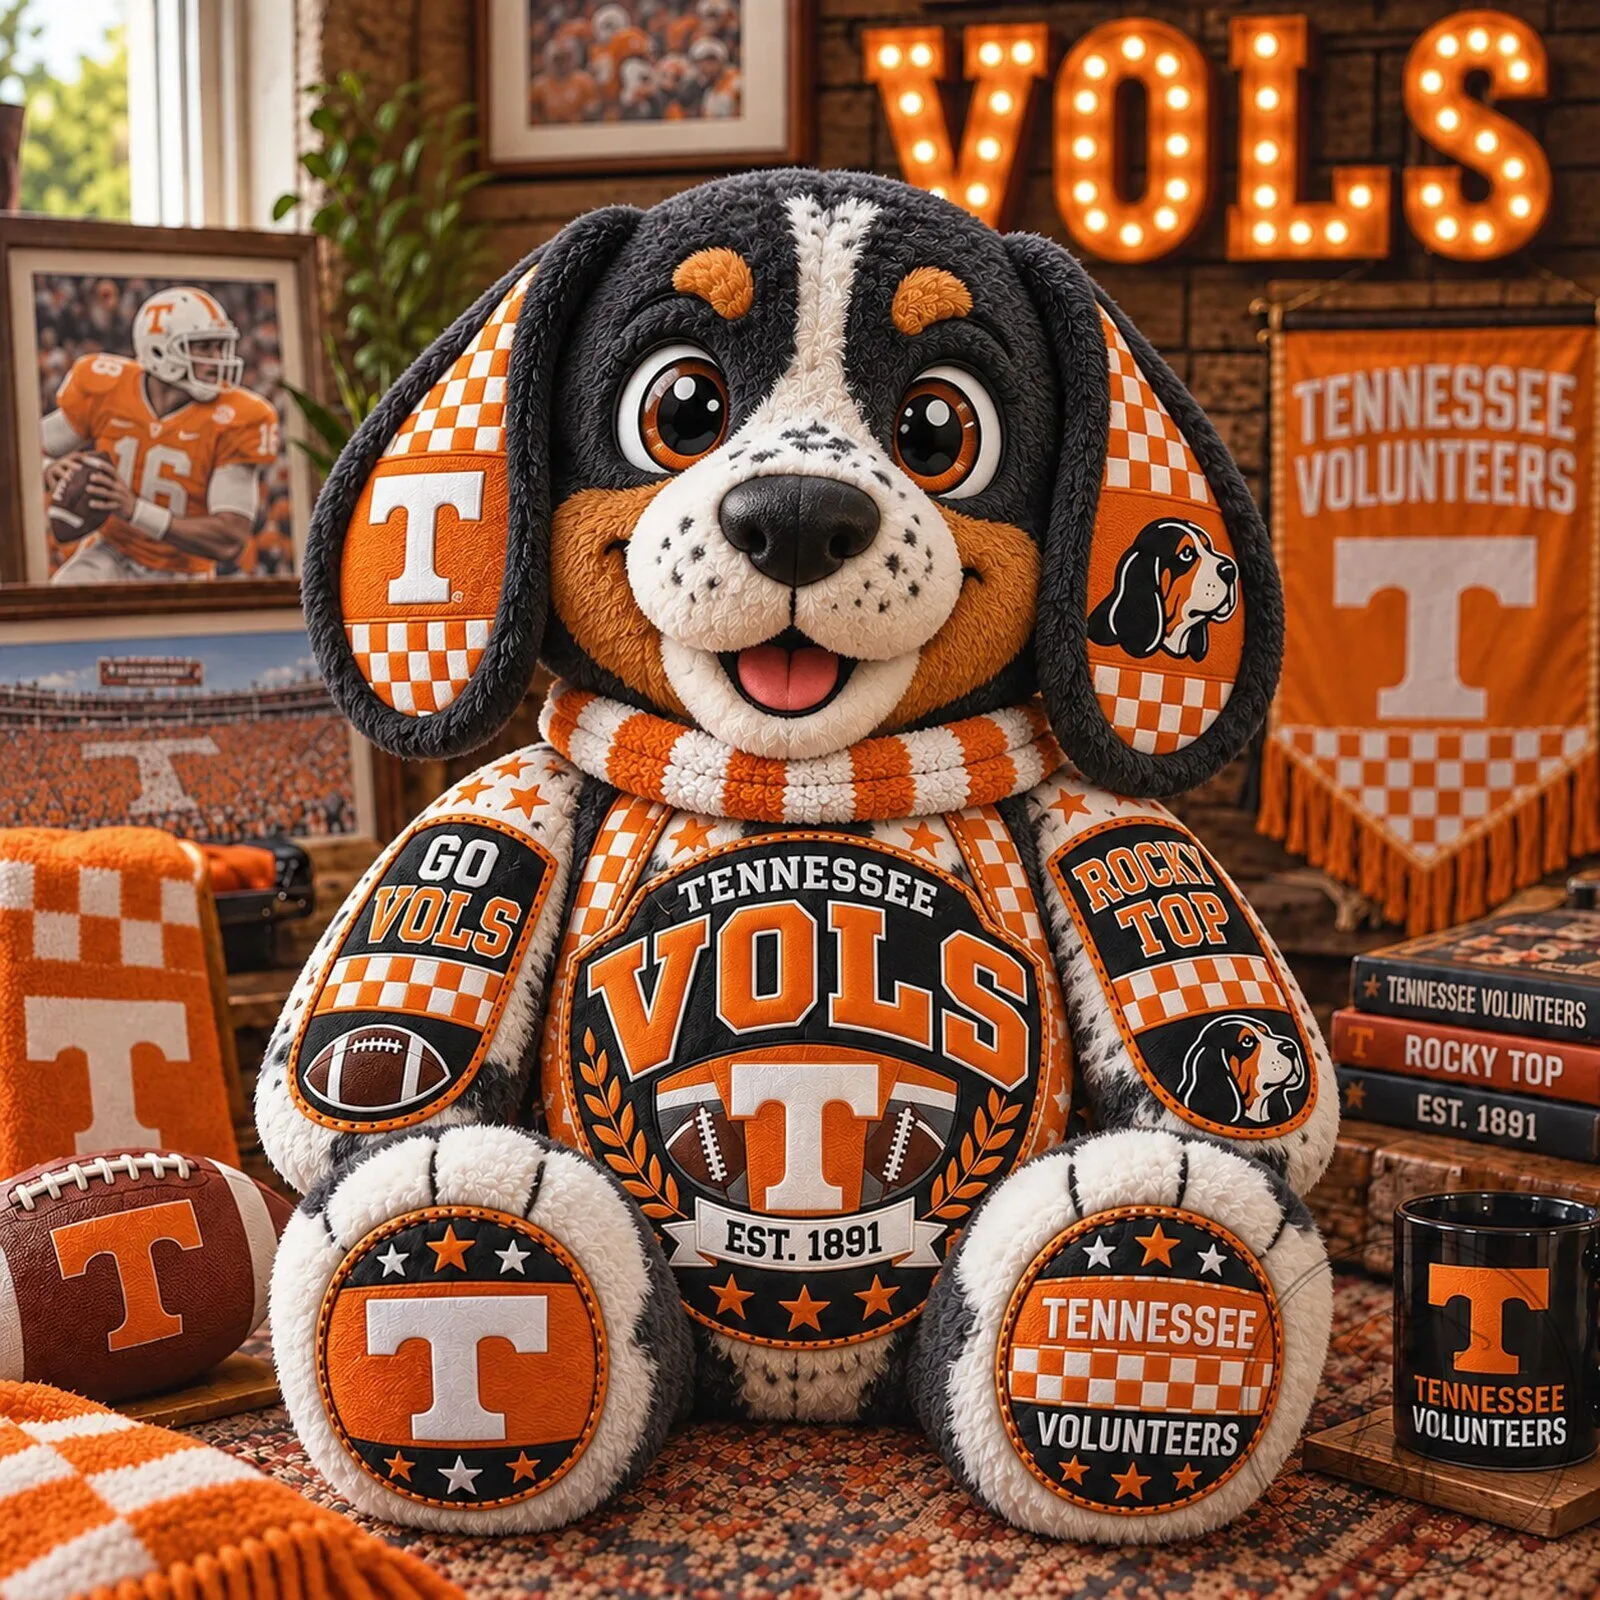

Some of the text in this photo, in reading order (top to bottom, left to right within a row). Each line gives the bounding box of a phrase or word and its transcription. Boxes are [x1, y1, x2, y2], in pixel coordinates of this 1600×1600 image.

[862, 10, 1551, 261] VOLS
[146, 303, 174, 336] T
[1292, 364, 1577, 445] TENNESSEE
[114, 436, 192, 521] 16
[1294, 439, 1577, 517] VOLUNTEERS
[369, 472, 484, 604] T
[1333, 536, 1537, 720] T
[418, 834, 499, 888] GO
[678, 855, 938, 918] TENNESSEE
[1071, 841, 1216, 914] ROCKY
[367, 884, 522, 959] VOLS
[1114, 891, 1229, 959] TOP
[586, 899, 1030, 1092] VOLS
[1387, 975, 1587, 1029] TENNESSEE VOLUNTEERS
[25, 997, 190, 1152] T
[1348, 1026, 1564, 1087] T ROCKY TOP
[731, 1063, 879, 1210] T
[1417, 1093, 1537, 1141] EST. 1891
[50, 1198, 204, 1352] T
[725, 1219, 882, 1262] EST. 1891
[1042, 1298, 1257, 1350] TENNESSEE
[1428, 1262, 1550, 1375] T
[366, 1295, 547, 1441] T
[1413, 1375, 1565, 1415] TENNESSEE
[1037, 1411, 1240, 1457] VOLUNTEERS
[1412, 1405, 1567, 1448] VOLUNTEERS
